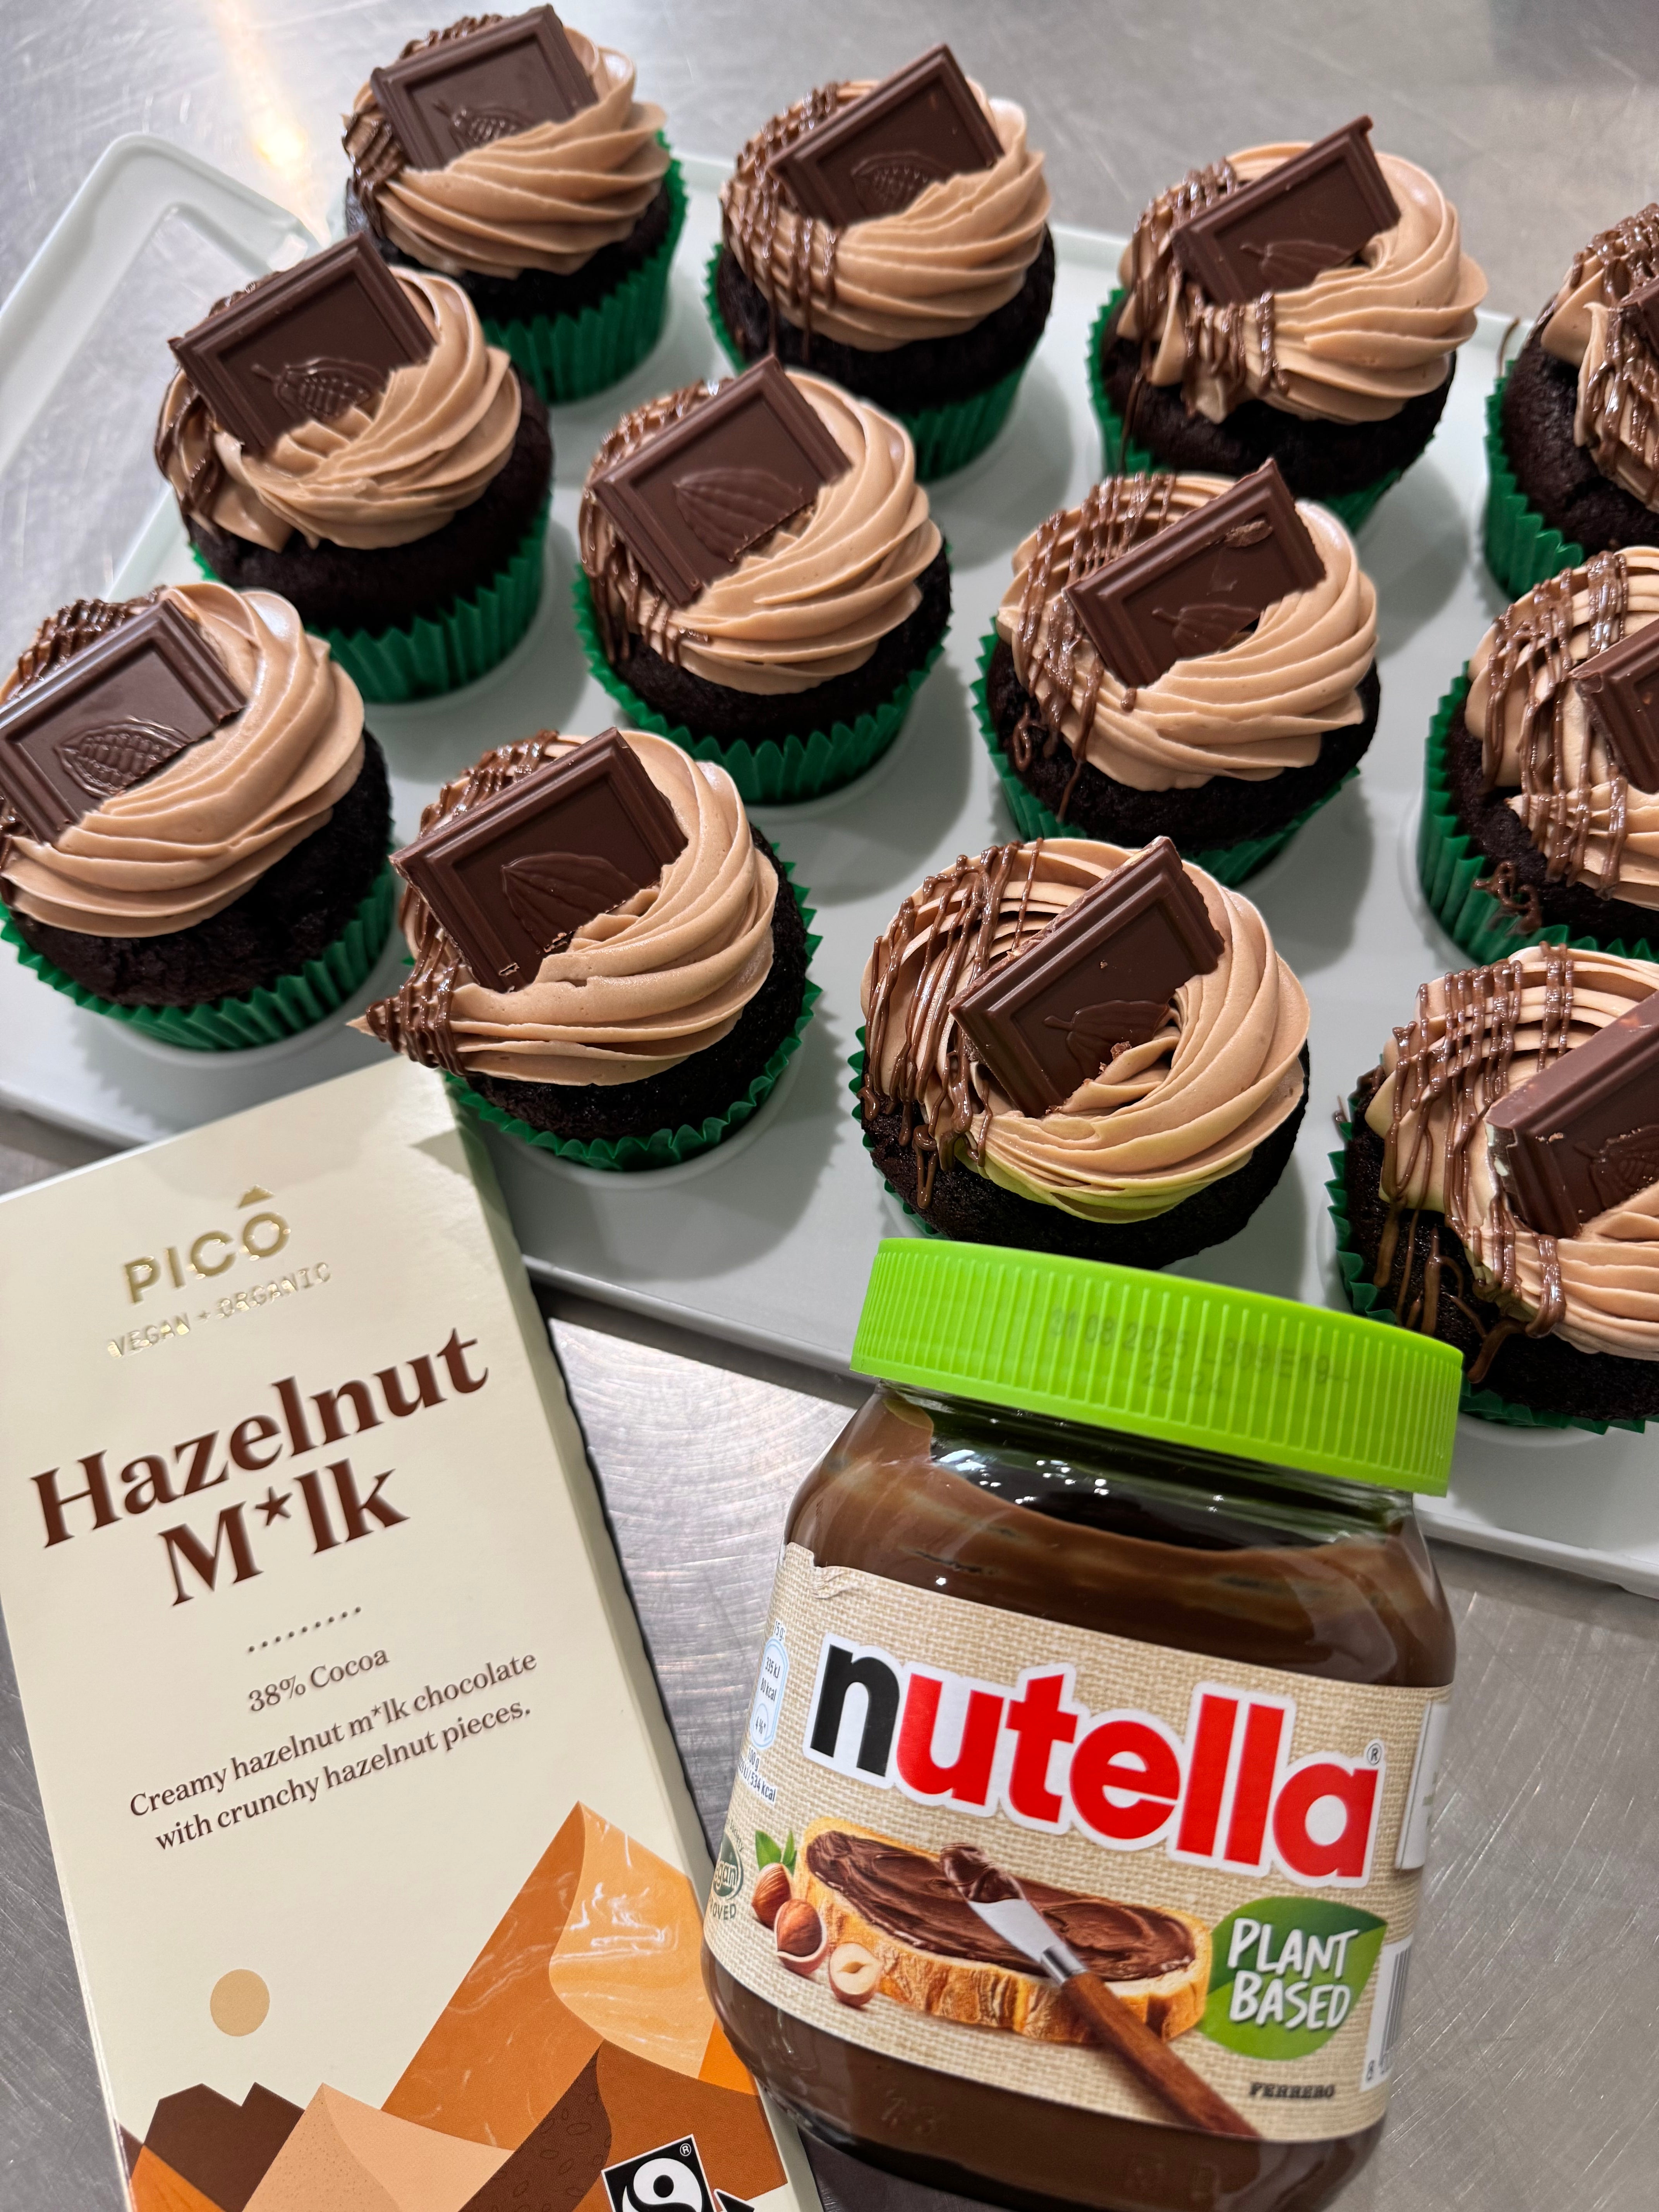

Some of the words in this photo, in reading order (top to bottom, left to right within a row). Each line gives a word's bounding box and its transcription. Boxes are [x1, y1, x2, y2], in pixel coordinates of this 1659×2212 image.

[108, 1313, 190, 1358] VEGAN
[216, 1261, 331, 1318] ORGANIC
[30, 1327, 489, 1549] Hazelnut
[249, 1674, 306, 1713] 38%
[311, 1649, 390, 1689] Cocoa
[765, 1656, 774, 1674] 335
[765, 1682, 777, 1702] kcal
[129, 1767, 228, 1816] Creamy
[230, 1721, 345, 1782] hazelnut
[413, 1650, 538, 1714] chocolate
[810, 1644, 1379, 1877] nutella
[156, 1812, 214, 1853] with
[216, 1775, 320, 1831] crunchy
[322, 1730, 439, 1791] hazelnut
[440, 1698, 532, 1750] pieces.
[750, 1772, 761, 1791] 534
[761, 1781, 776, 1802] kcal
[755, 1758, 759, 1771] g
[1227, 1918, 1360, 1980] PLANT
[1229, 1970, 1351, 2030] BASED
[1249, 2082, 1336, 2098] FERRERO
